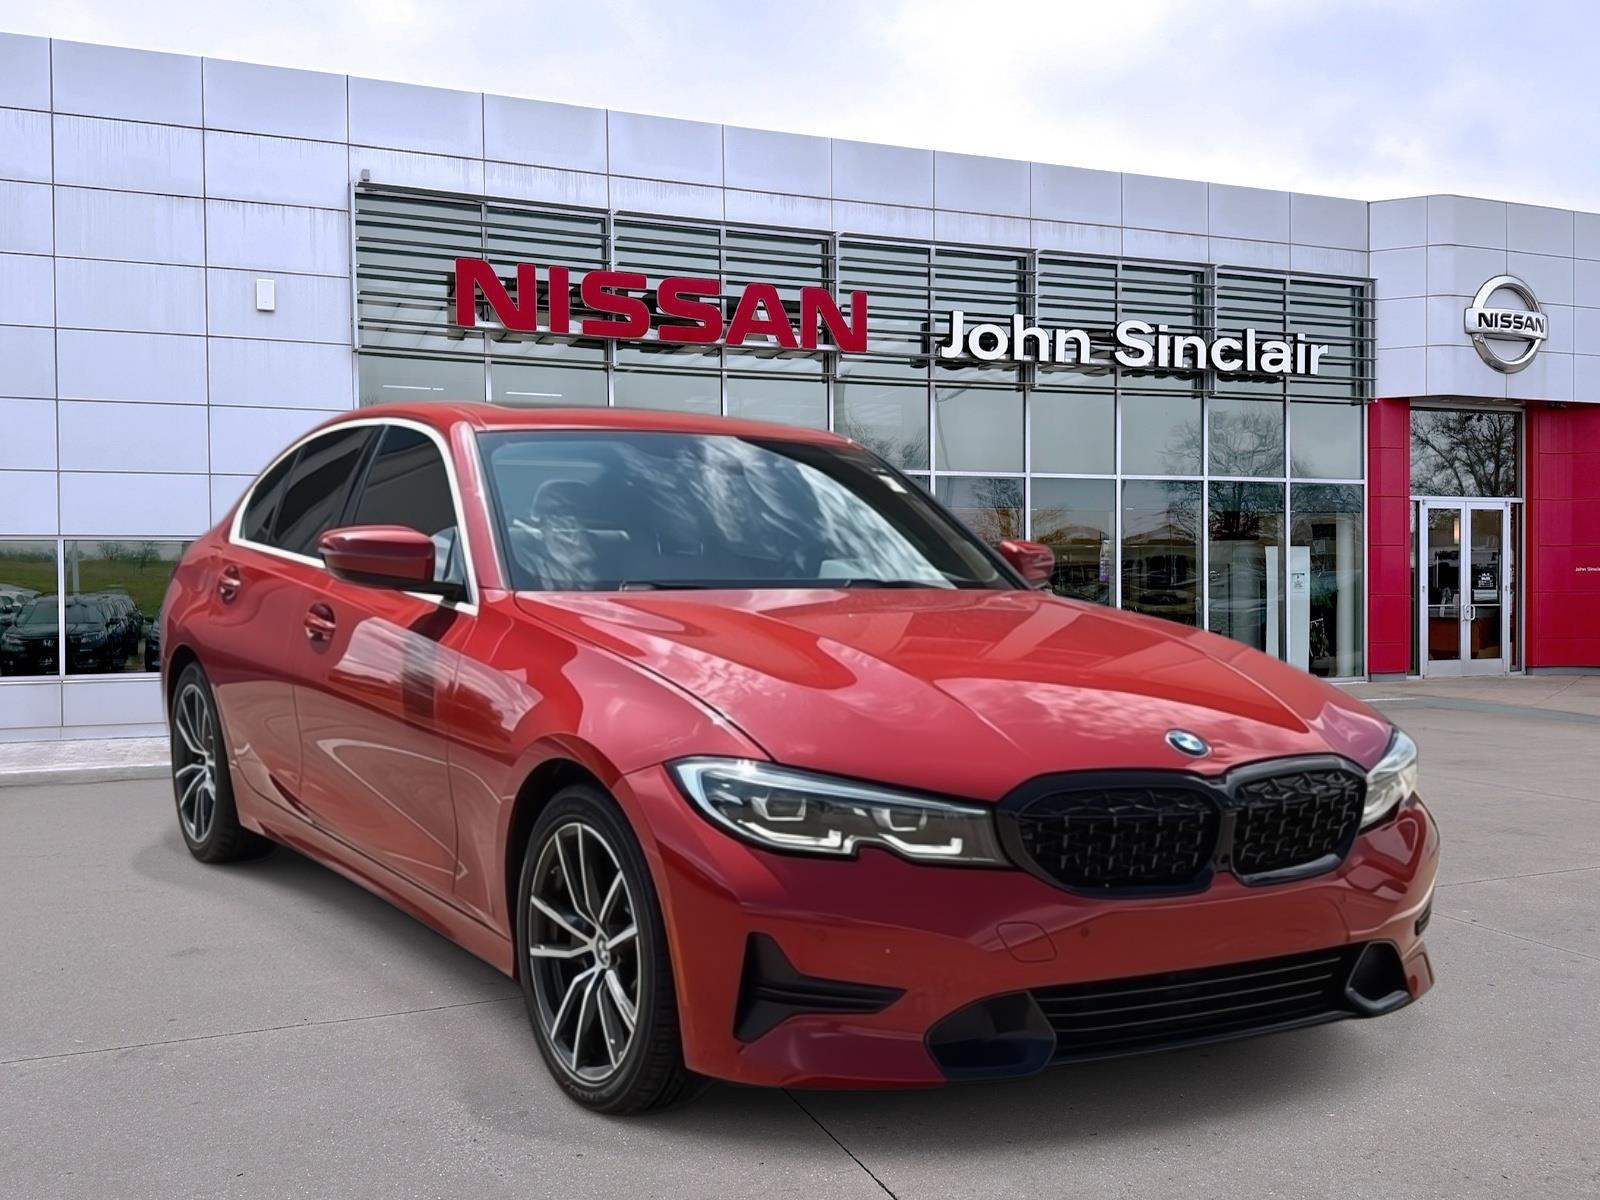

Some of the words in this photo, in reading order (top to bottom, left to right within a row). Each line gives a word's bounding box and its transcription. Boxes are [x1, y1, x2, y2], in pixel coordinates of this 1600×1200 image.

[455, 257, 868, 353] NISSAN
[1477, 312, 1545, 334] NISSAN
[940, 310, 1091, 364] John
[1114, 319, 1329, 375] Sinclair
